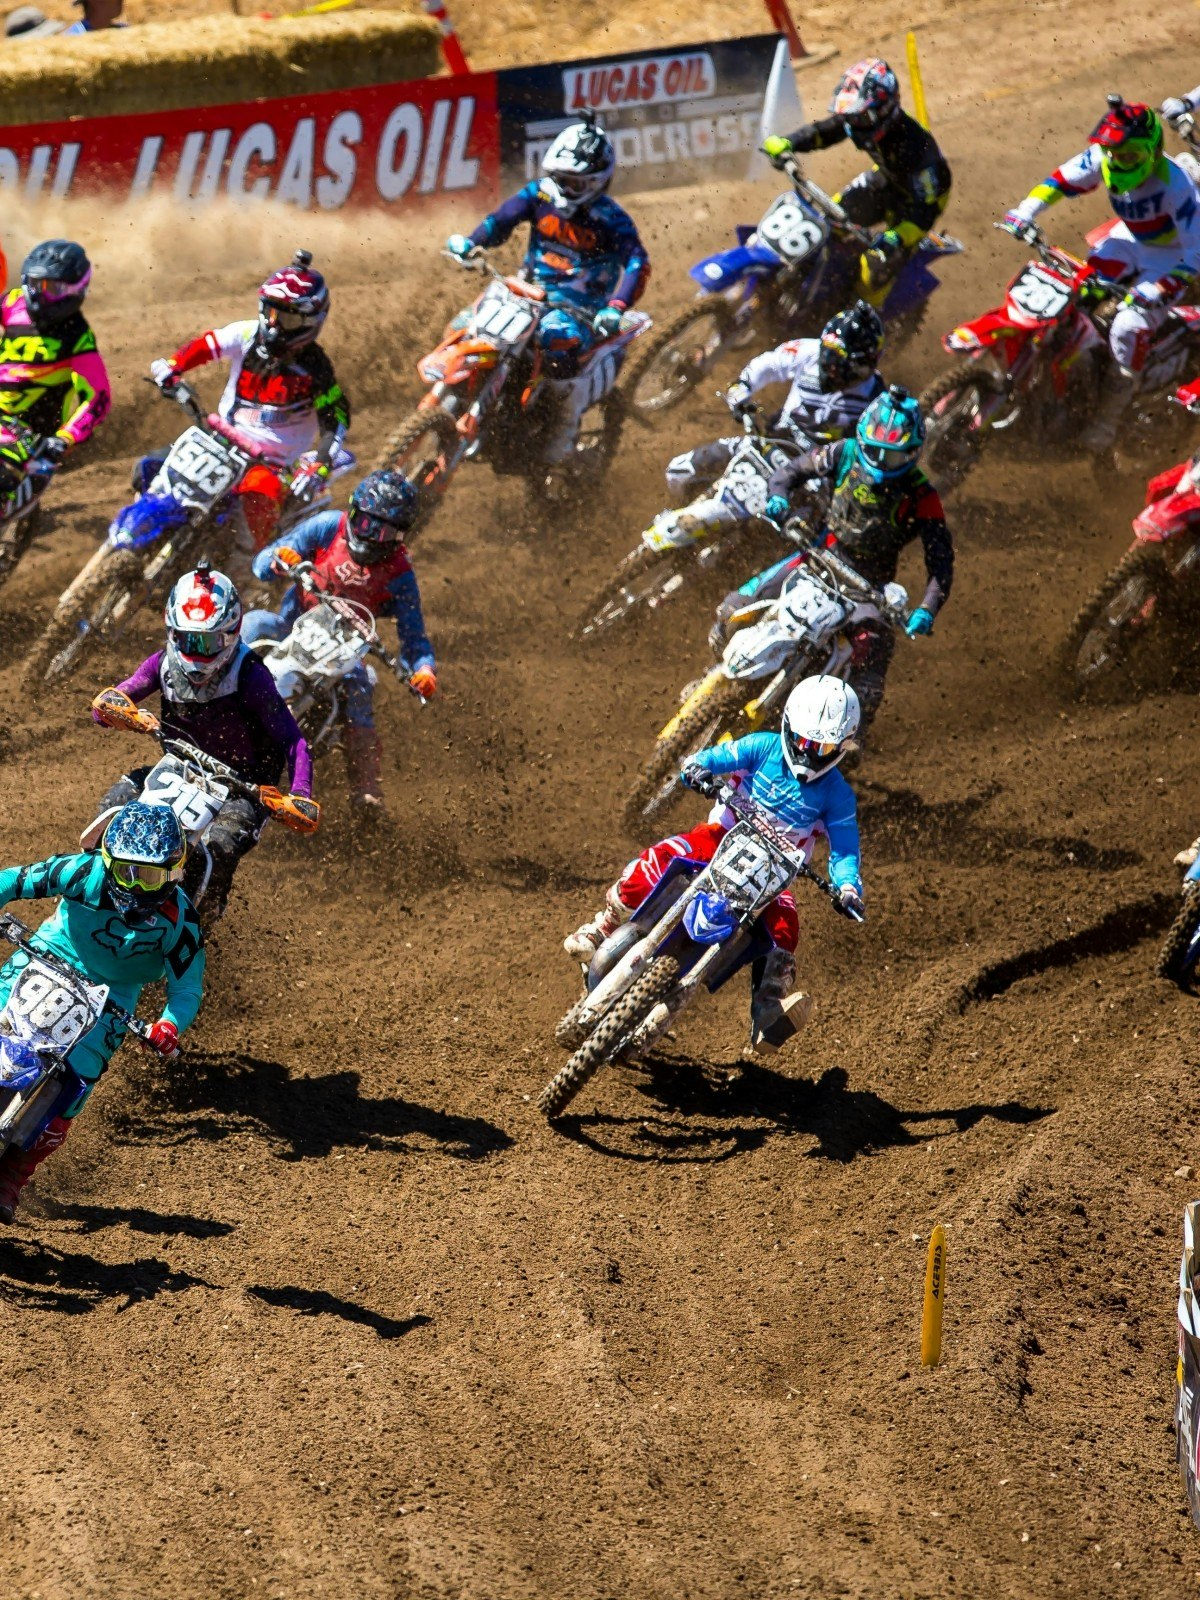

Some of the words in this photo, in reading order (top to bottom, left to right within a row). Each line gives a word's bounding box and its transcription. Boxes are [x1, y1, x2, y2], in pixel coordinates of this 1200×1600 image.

[571, 64, 657, 108] LUCAS
[664, 57, 709, 97] OIL
[129, 110, 363, 211] LUCAS
[376, 96, 481, 201] OIL
[525, 112, 764, 179] MOCROSS
[760, 204, 823, 257] 86
[169, 440, 233, 495] 503
[139, 771, 229, 832] 215
[8, 973, 92, 1045] 986
